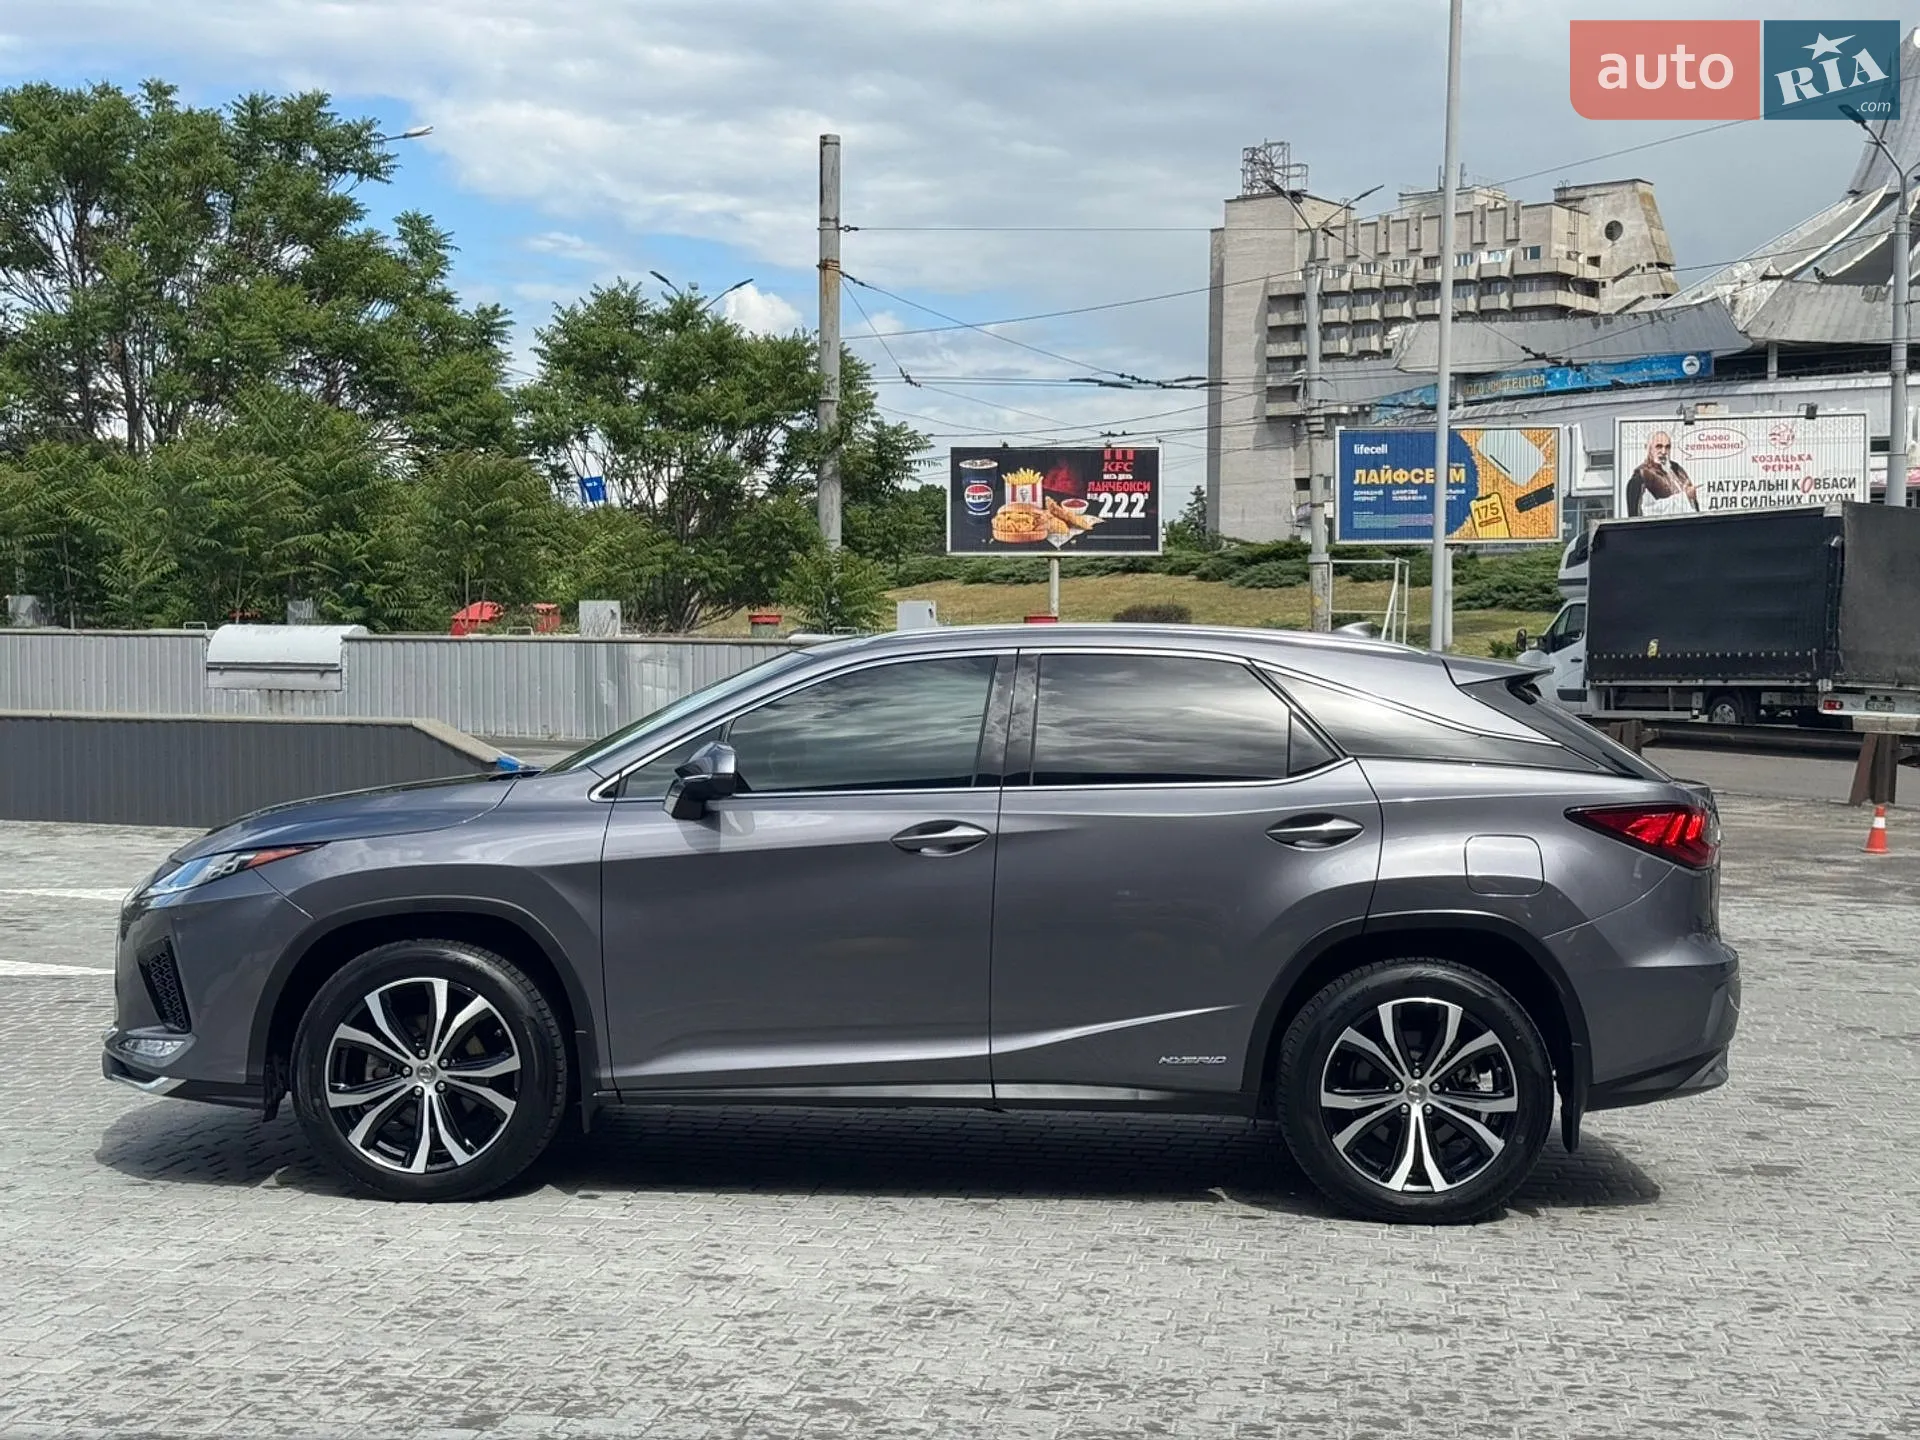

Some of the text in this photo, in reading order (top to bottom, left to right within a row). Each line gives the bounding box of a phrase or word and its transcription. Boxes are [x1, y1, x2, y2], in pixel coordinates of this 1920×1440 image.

[1697, 433, 1731, 442] Слово
[1353, 443, 1388, 455] lifecell
[1751, 453, 1814, 464] КОЗАЦЬКА
[1103, 461, 1134, 472] KFC
[1761, 463, 1802, 473] ФЕРМА
[1087, 481, 1151, 492] ЛАНЧБОКСИ
[1706, 475, 1857, 494] НАТУРАЛЬНІ КОВБАСИ
[1708, 495, 1738, 510] ДЛЯ
[1740, 493, 1803, 508] СИЛЬНИХ
[1473, 502, 1500, 520] 175
